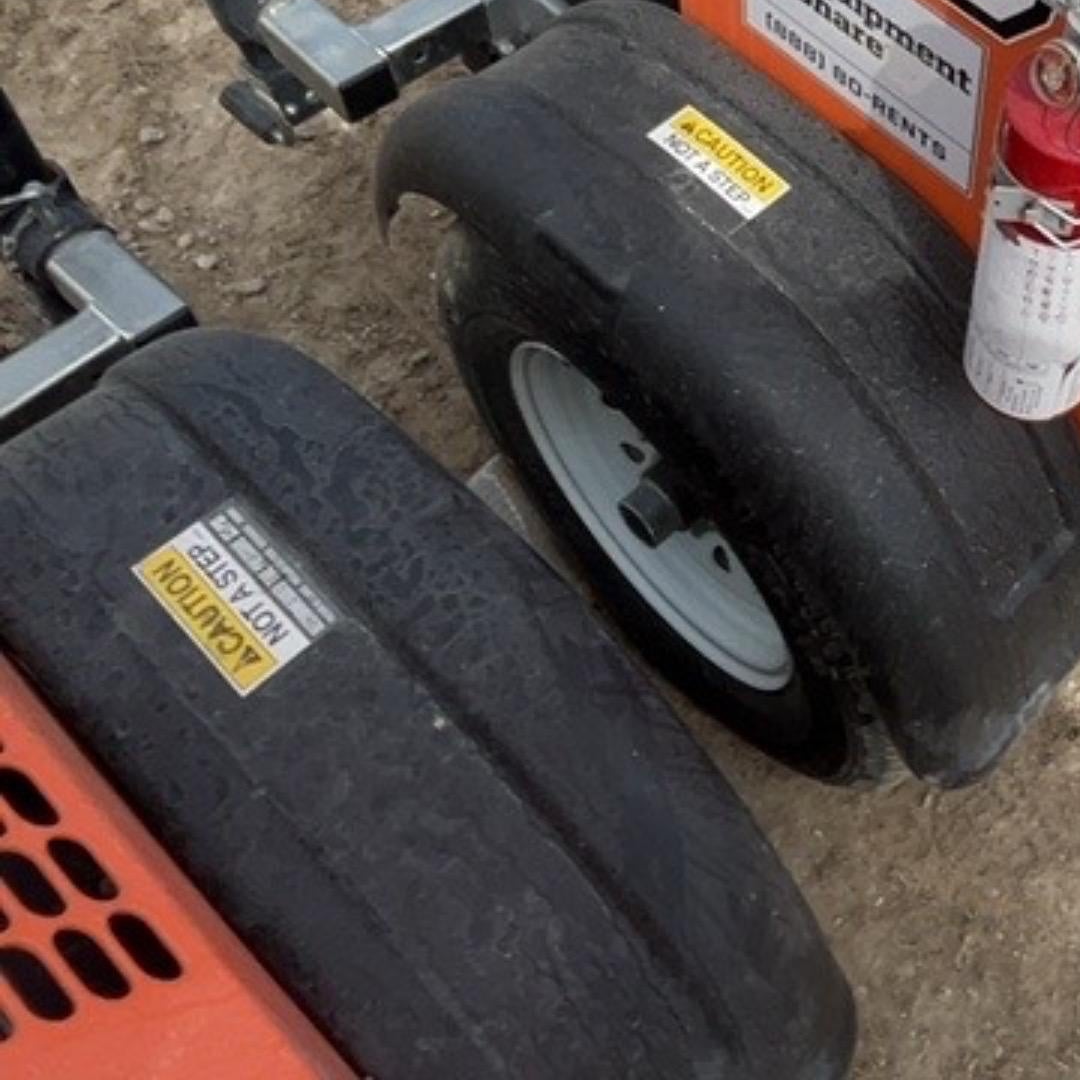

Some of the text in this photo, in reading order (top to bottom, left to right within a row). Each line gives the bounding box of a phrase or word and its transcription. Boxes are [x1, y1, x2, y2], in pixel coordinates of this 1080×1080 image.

[764, 11, 826, 70] (888)
[665, 134, 699, 160] NOT
[707, 171, 751, 202] STEP
[696, 129, 773, 193] CAUTION
[152, 557, 244, 655] CAUTION
[189, 545, 289, 646] NOT A STEP
